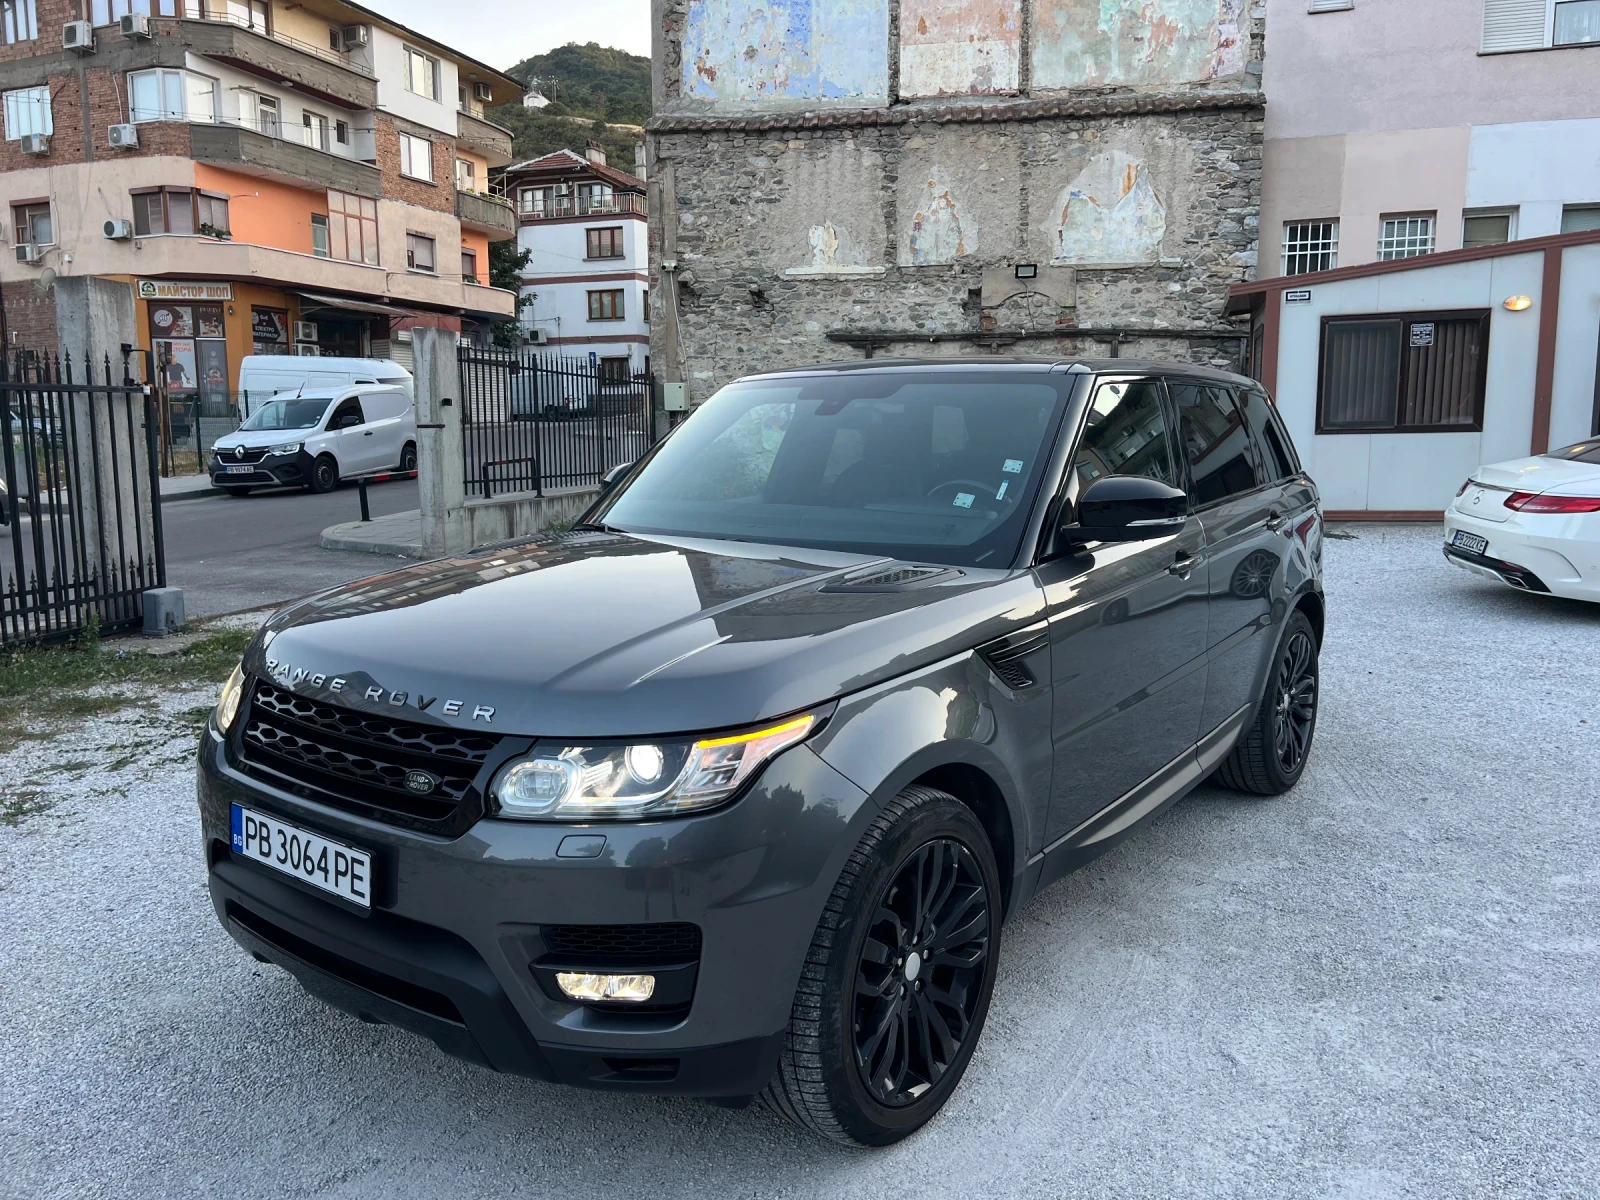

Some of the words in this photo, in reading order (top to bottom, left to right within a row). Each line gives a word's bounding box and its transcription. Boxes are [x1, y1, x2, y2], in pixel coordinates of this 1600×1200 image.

[157, 282, 204, 297] МАЙСТОР
[206, 286, 229, 298] ШОП
[254, 325, 275, 333] ЕЛЕКТРО
[265, 657, 347, 694] RANGE
[364, 685, 496, 724] ROVER
[410, 781, 429, 791] ROVER
[233, 833, 243, 846] BG
